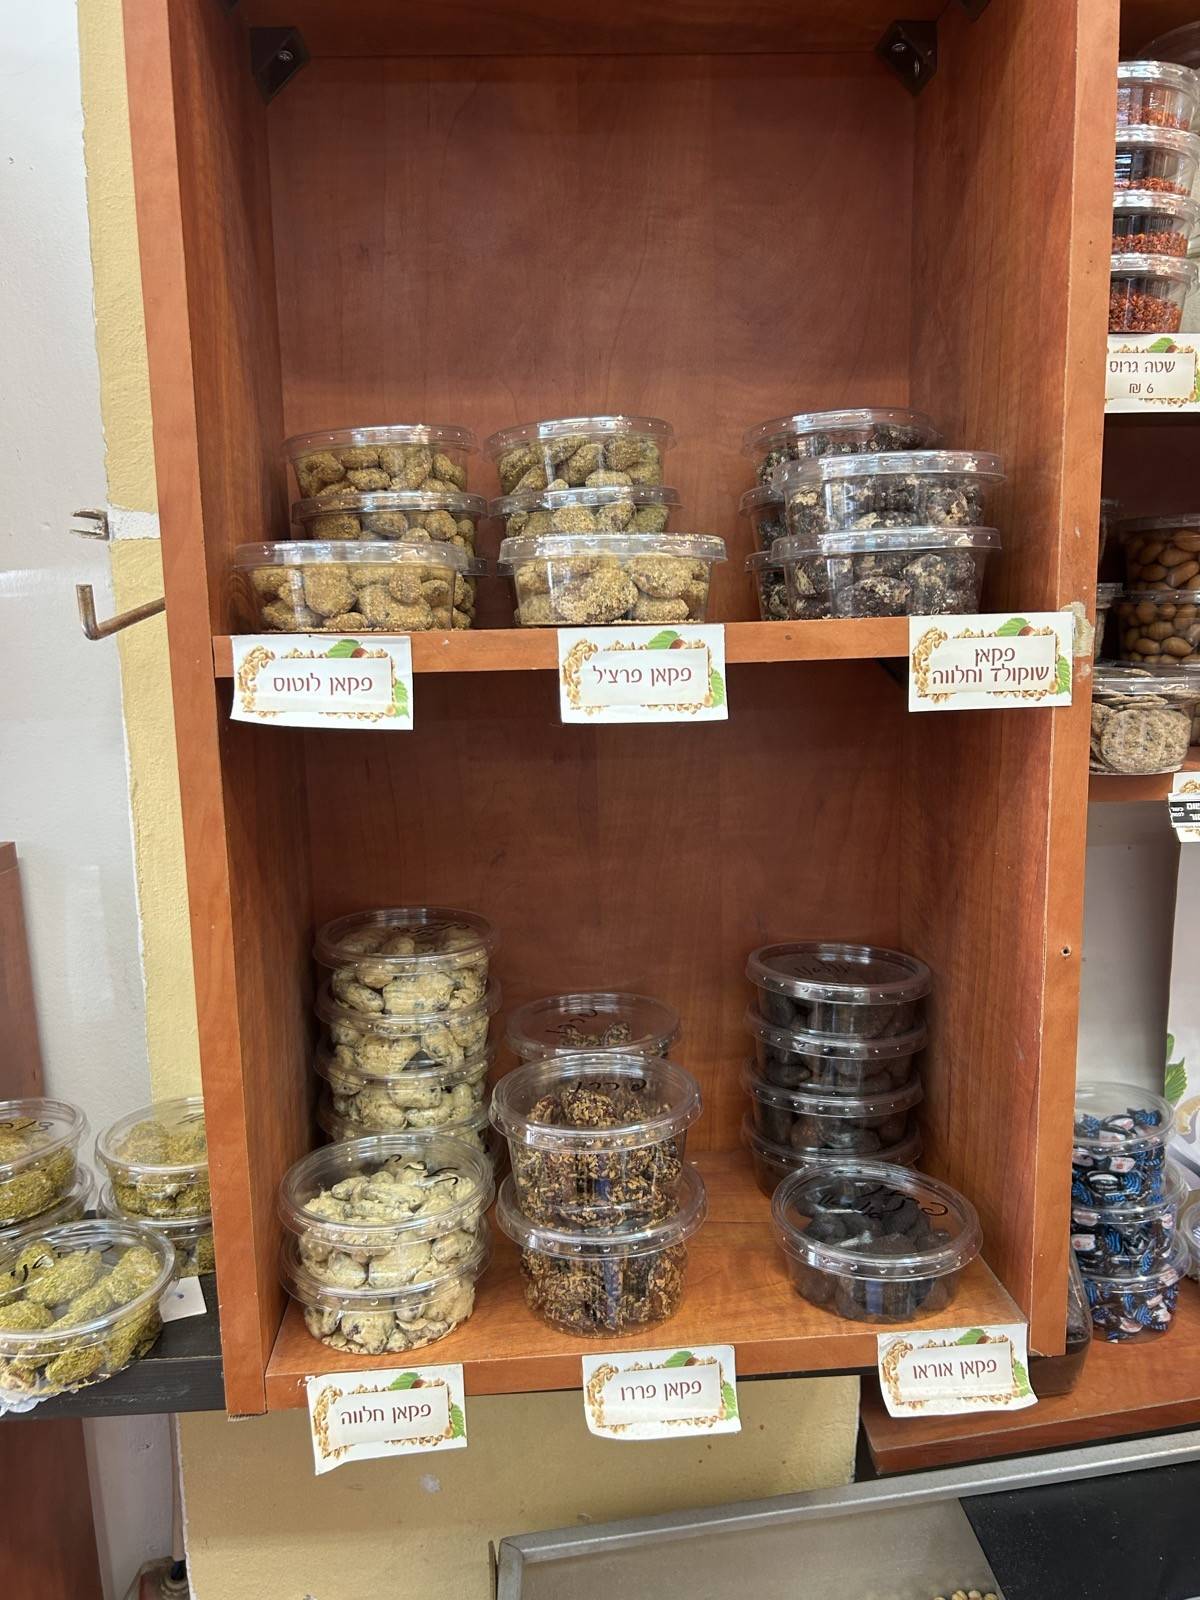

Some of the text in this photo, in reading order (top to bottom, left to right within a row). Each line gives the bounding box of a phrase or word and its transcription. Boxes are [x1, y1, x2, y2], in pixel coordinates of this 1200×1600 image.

[1109, 360, 1176, 373] שטה גרוס
[1128, 383, 1154, 394] 6 ₪
[273, 672, 373, 696] פקאן לוטוס
[650, 667, 692, 687] פקאן
[932, 662, 1050, 686] שוקולד וחלווה
[912, 1359, 997, 1380] פקאן אוראו
[620, 1380, 702, 1401] פקאן פררו
[340, 1403, 432, 1425] פקאן חלווה
